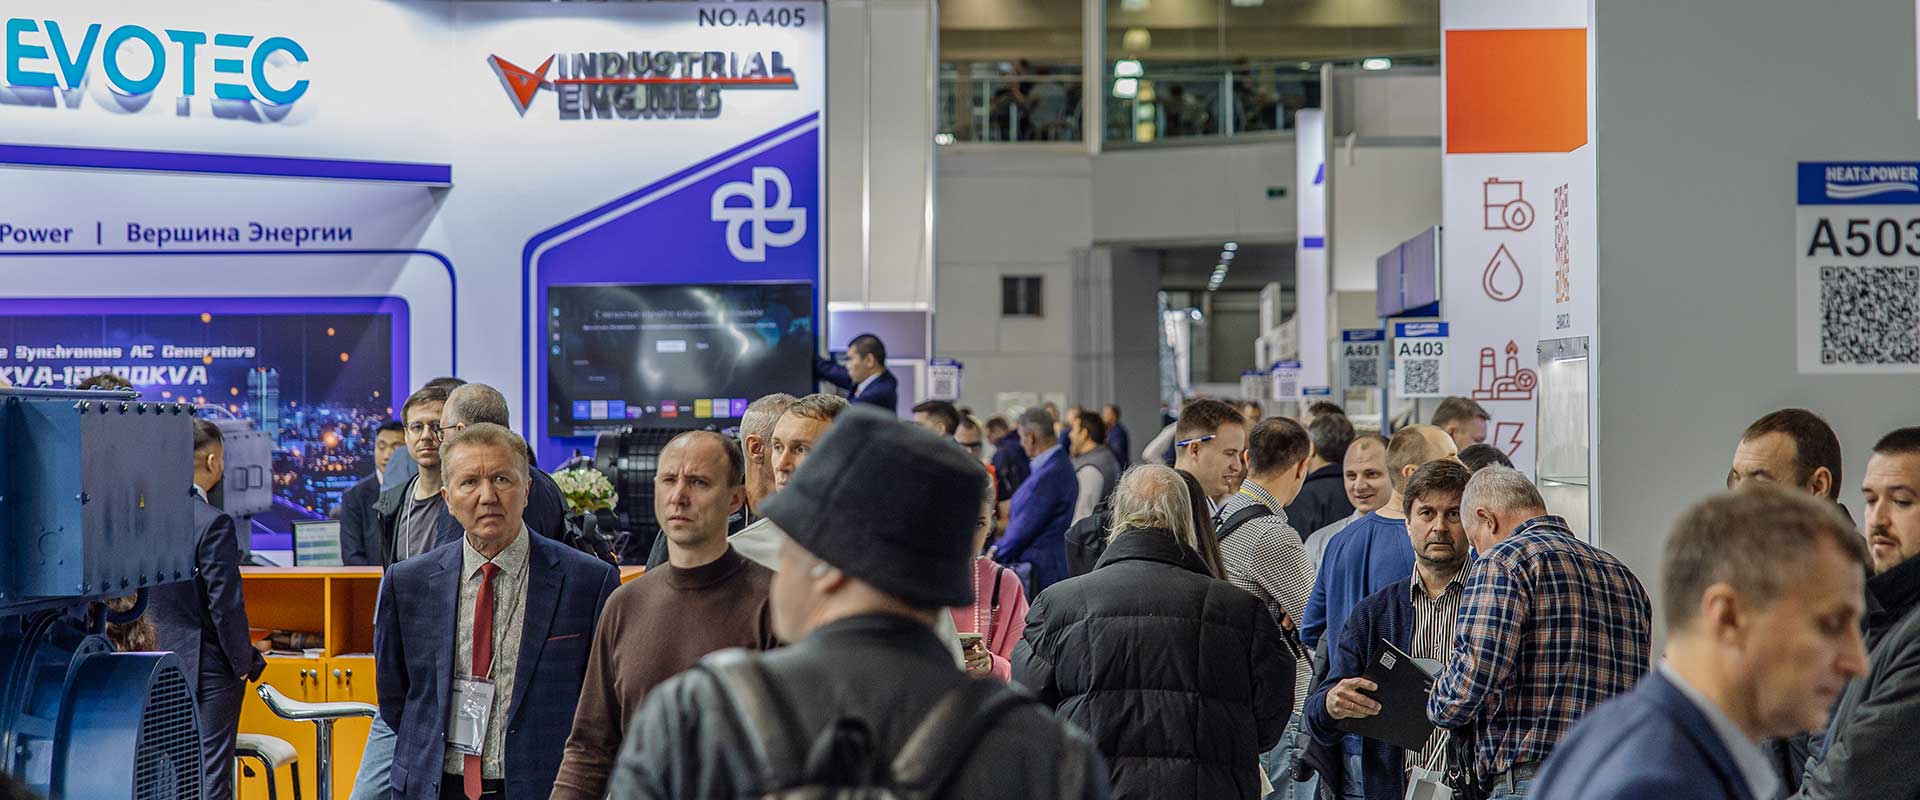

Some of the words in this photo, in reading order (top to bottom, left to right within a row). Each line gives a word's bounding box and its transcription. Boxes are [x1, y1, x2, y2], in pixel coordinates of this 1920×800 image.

[698, 8, 806, 27] NO.A405
[6, 17, 310, 105] EVOTEC
[558, 51, 793, 79] INDUSTRIAL
[558, 83, 722, 119] ENGINES
[1825, 166, 1918, 181] HEAT&POWER
[0, 223, 73, 243] Power
[127, 223, 240, 247] Вершина
[248, 222, 352, 247] Энергии
[1806, 217, 1920, 257] A503
[15, 344, 122, 362] Synchronous
[130, 345, 153, 358] AC
[162, 345, 256, 358] Generators
[1345, 344, 1380, 356] A401
[1399, 342, 1444, 356] A403
